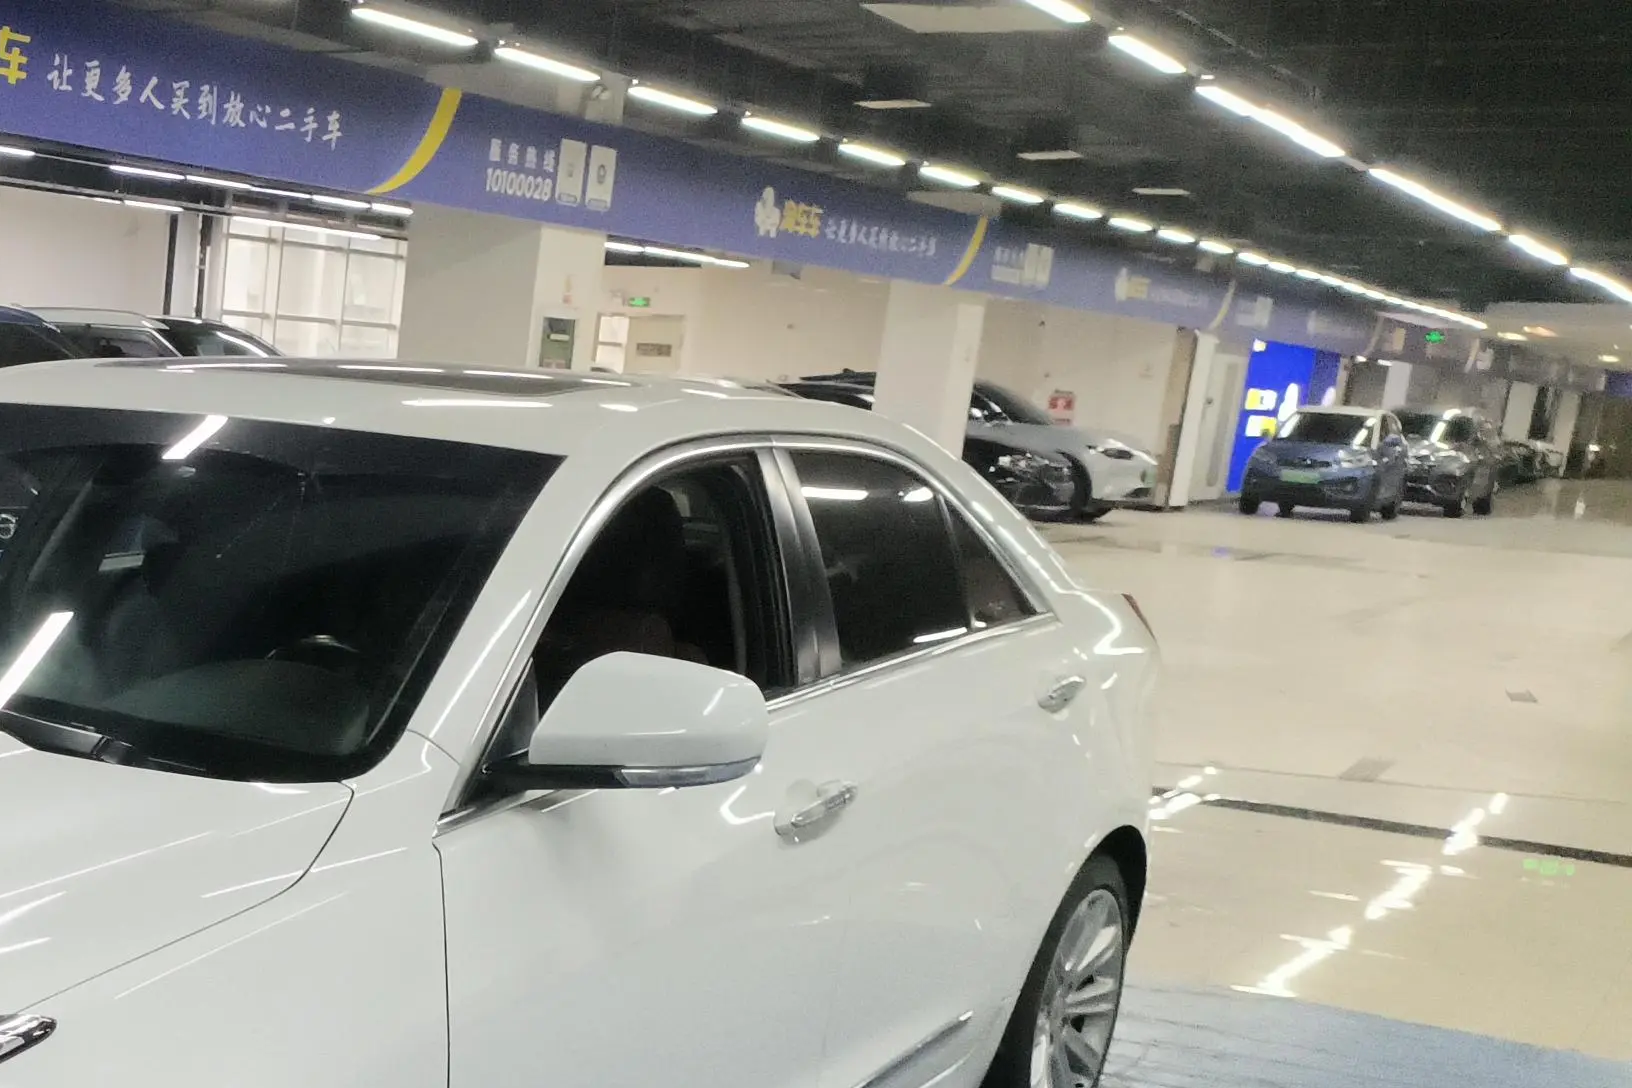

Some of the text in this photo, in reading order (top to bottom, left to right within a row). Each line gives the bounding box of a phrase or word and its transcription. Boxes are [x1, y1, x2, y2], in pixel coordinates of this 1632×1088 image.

[47, 54, 343, 151] 让更多人买到放心二手车
[486, 167, 554, 202] 10100028
